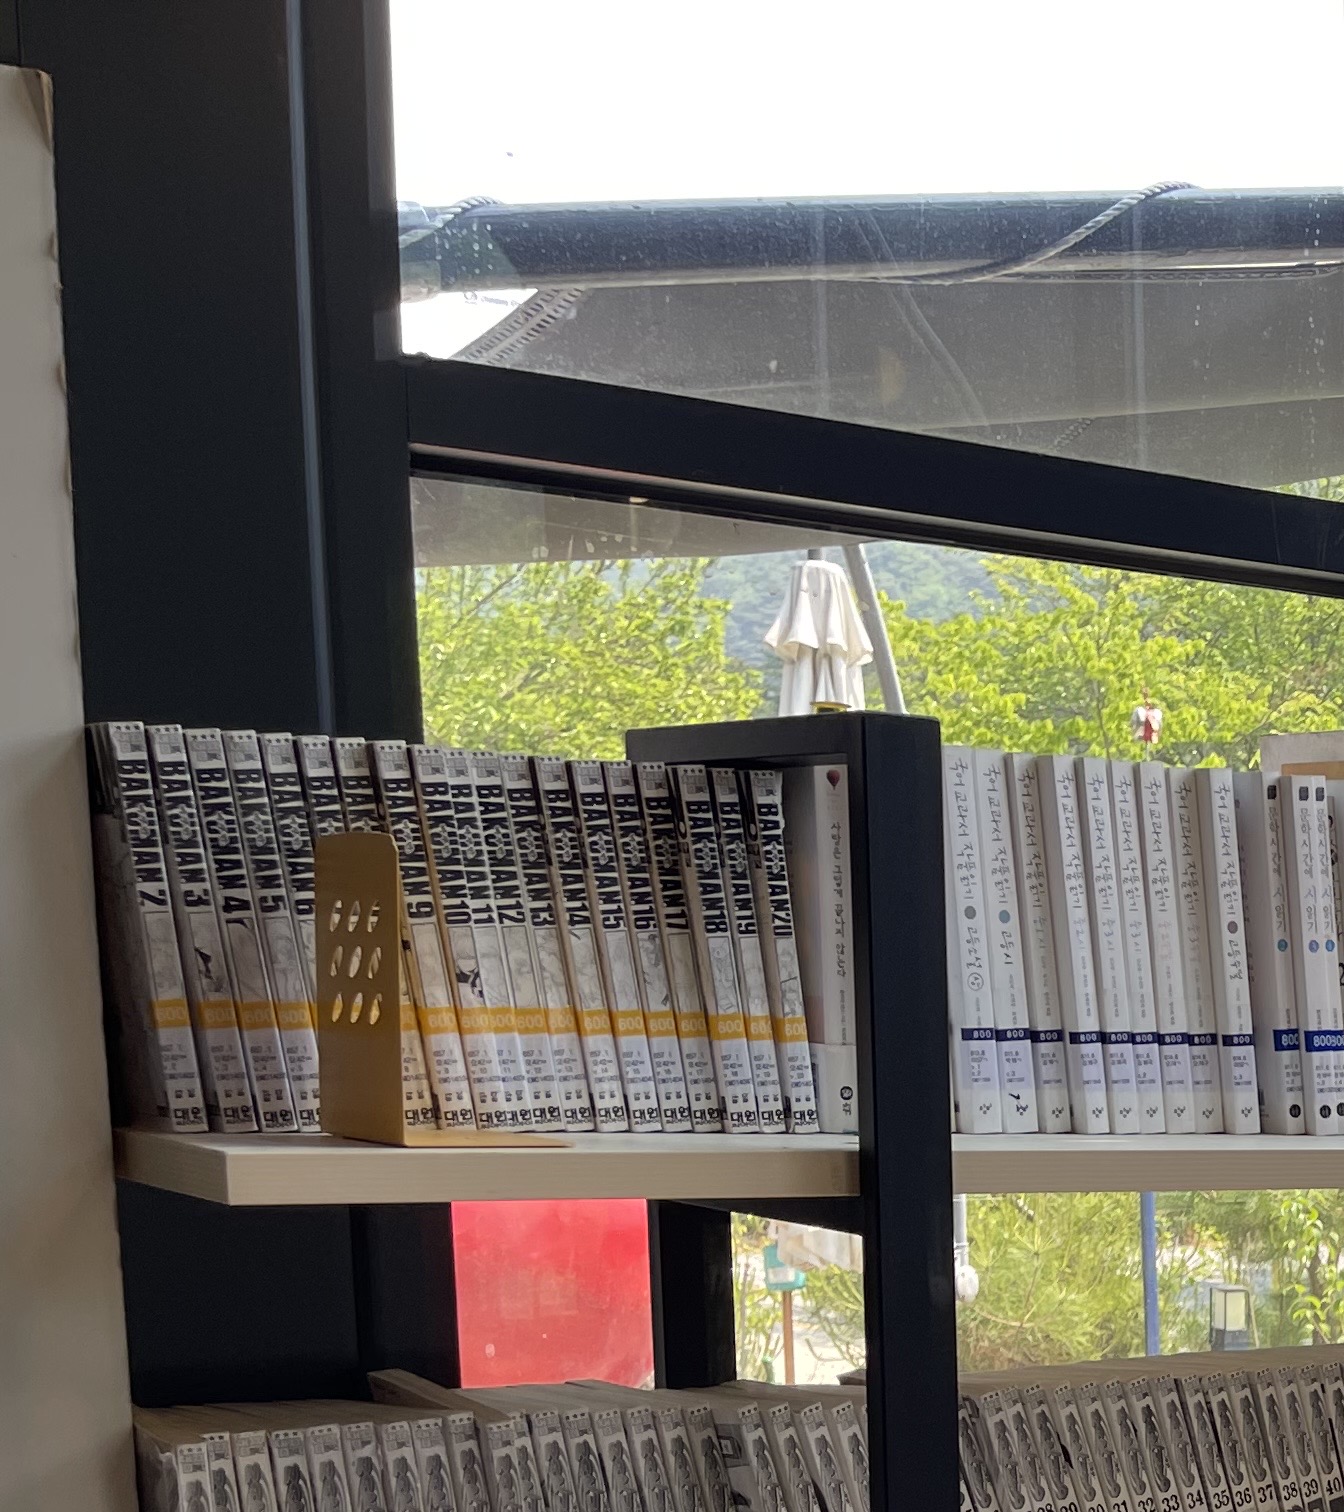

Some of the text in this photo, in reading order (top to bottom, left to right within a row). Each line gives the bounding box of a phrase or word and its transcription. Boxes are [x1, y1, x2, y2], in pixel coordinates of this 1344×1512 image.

[138, 889, 168, 906] 2
[182, 889, 212, 906] 3
[223, 896, 250, 913] 4
[259, 896, 284, 912] 5
[497, 900, 526, 924] 12
[634, 905, 657, 929] 16
[972, 1030, 992, 1039] 800
[1006, 1030, 1025, 1039] 800
[1235, 1487, 1252, 1506] 36
